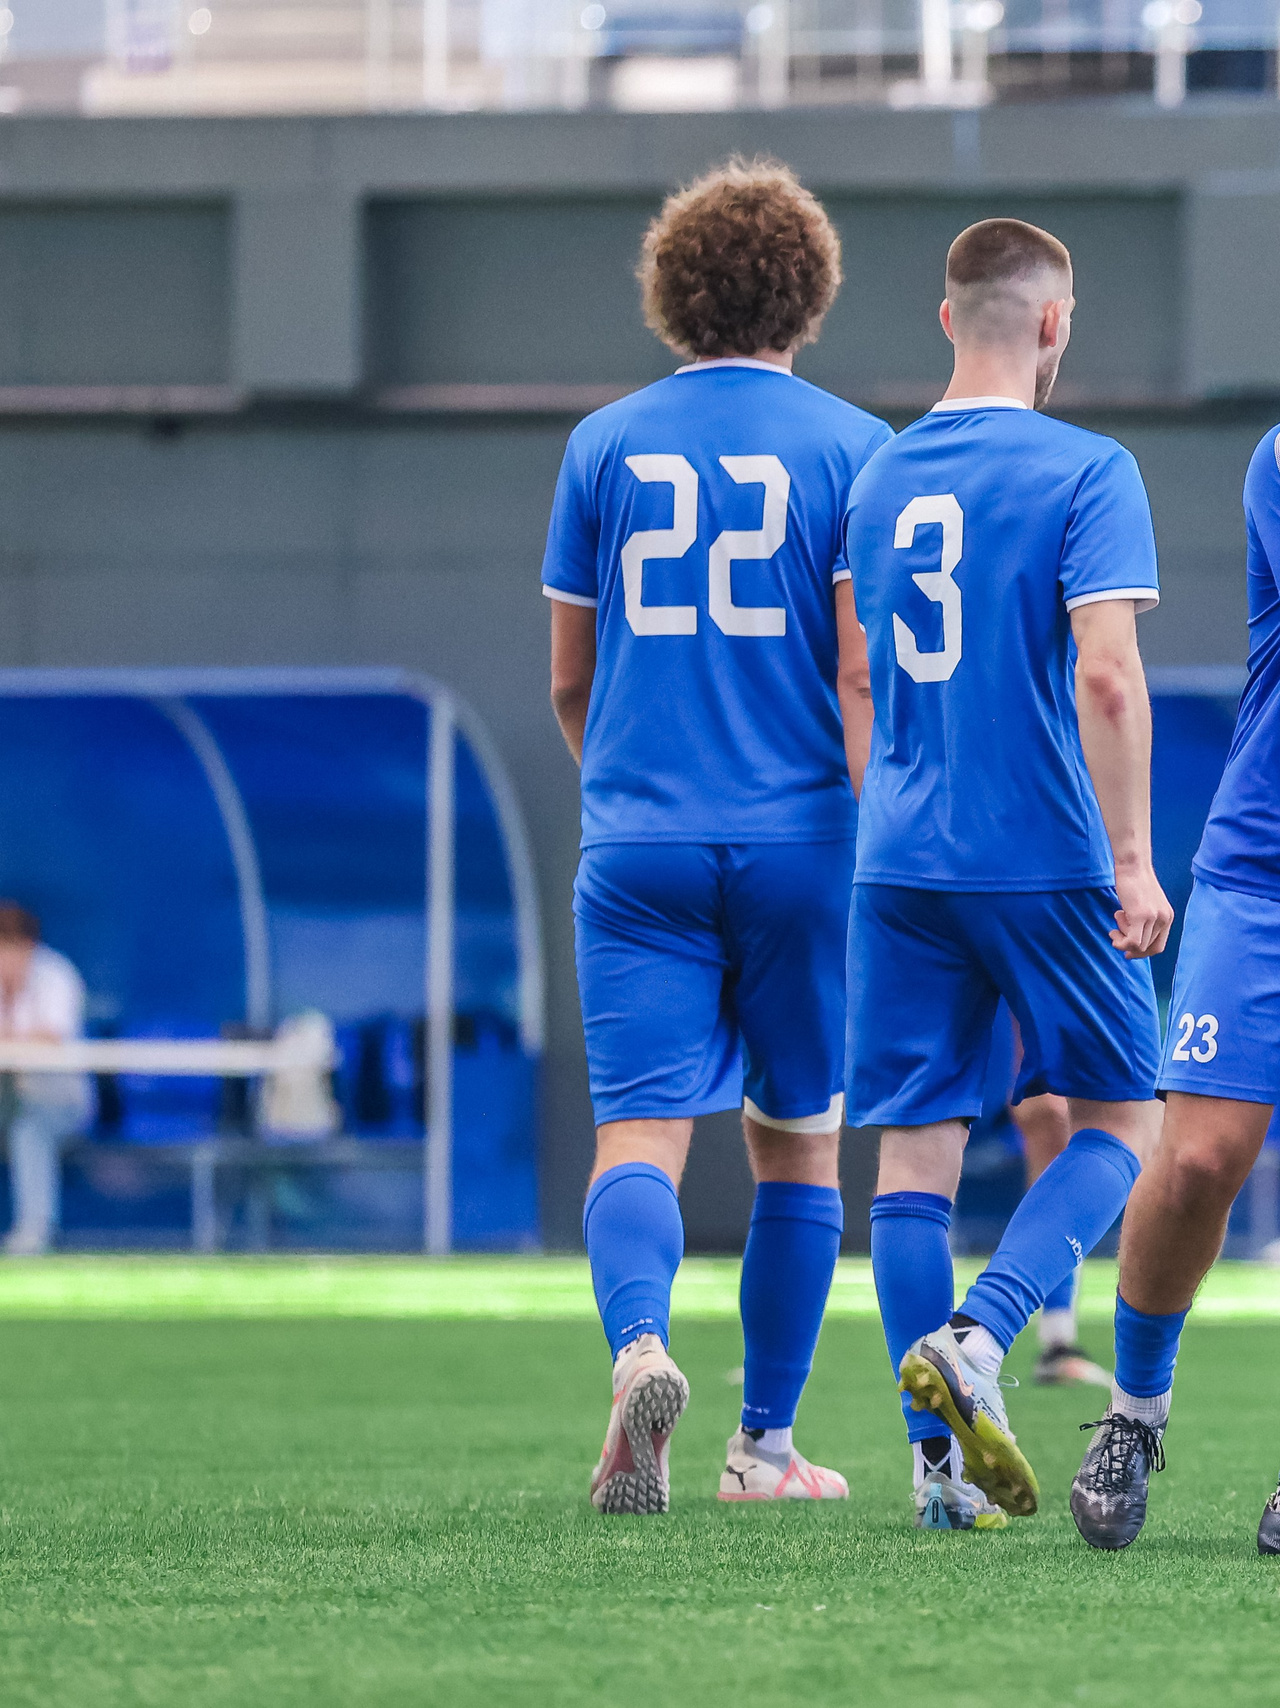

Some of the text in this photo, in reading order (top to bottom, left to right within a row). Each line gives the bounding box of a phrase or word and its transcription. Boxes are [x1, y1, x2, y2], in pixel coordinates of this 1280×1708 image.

[621, 454, 791, 637] 22
[892, 493, 964, 683] 3
[1171, 1012, 1219, 1063] 23
